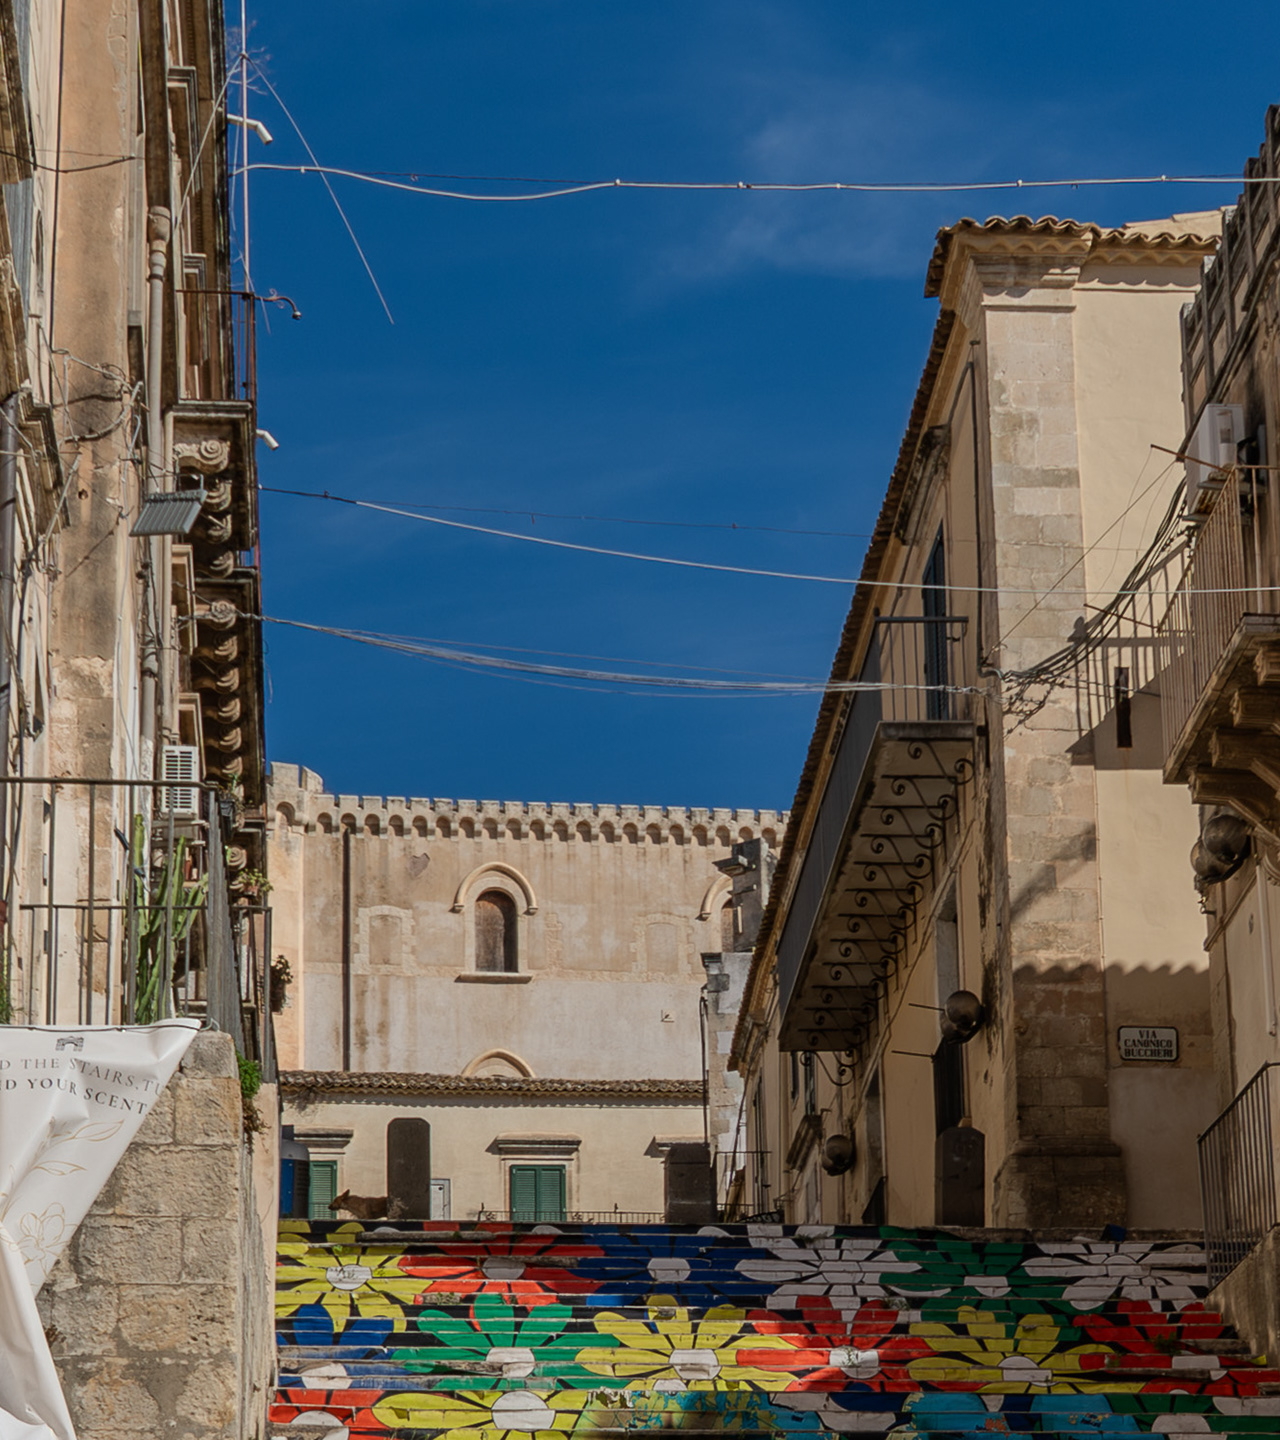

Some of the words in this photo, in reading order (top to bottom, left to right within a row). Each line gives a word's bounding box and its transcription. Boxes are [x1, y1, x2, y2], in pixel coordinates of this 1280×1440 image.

[1139, 1030, 1157, 1039] VIA
[1124, 1039, 1173, 1048] CANONICO
[1124, 1048, 1173, 1058] BUCCHERI
[23, 1058, 60, 1070] THE
[27, 1079, 77, 1095] YOUR
[83, 1087, 148, 1115] SCENT
